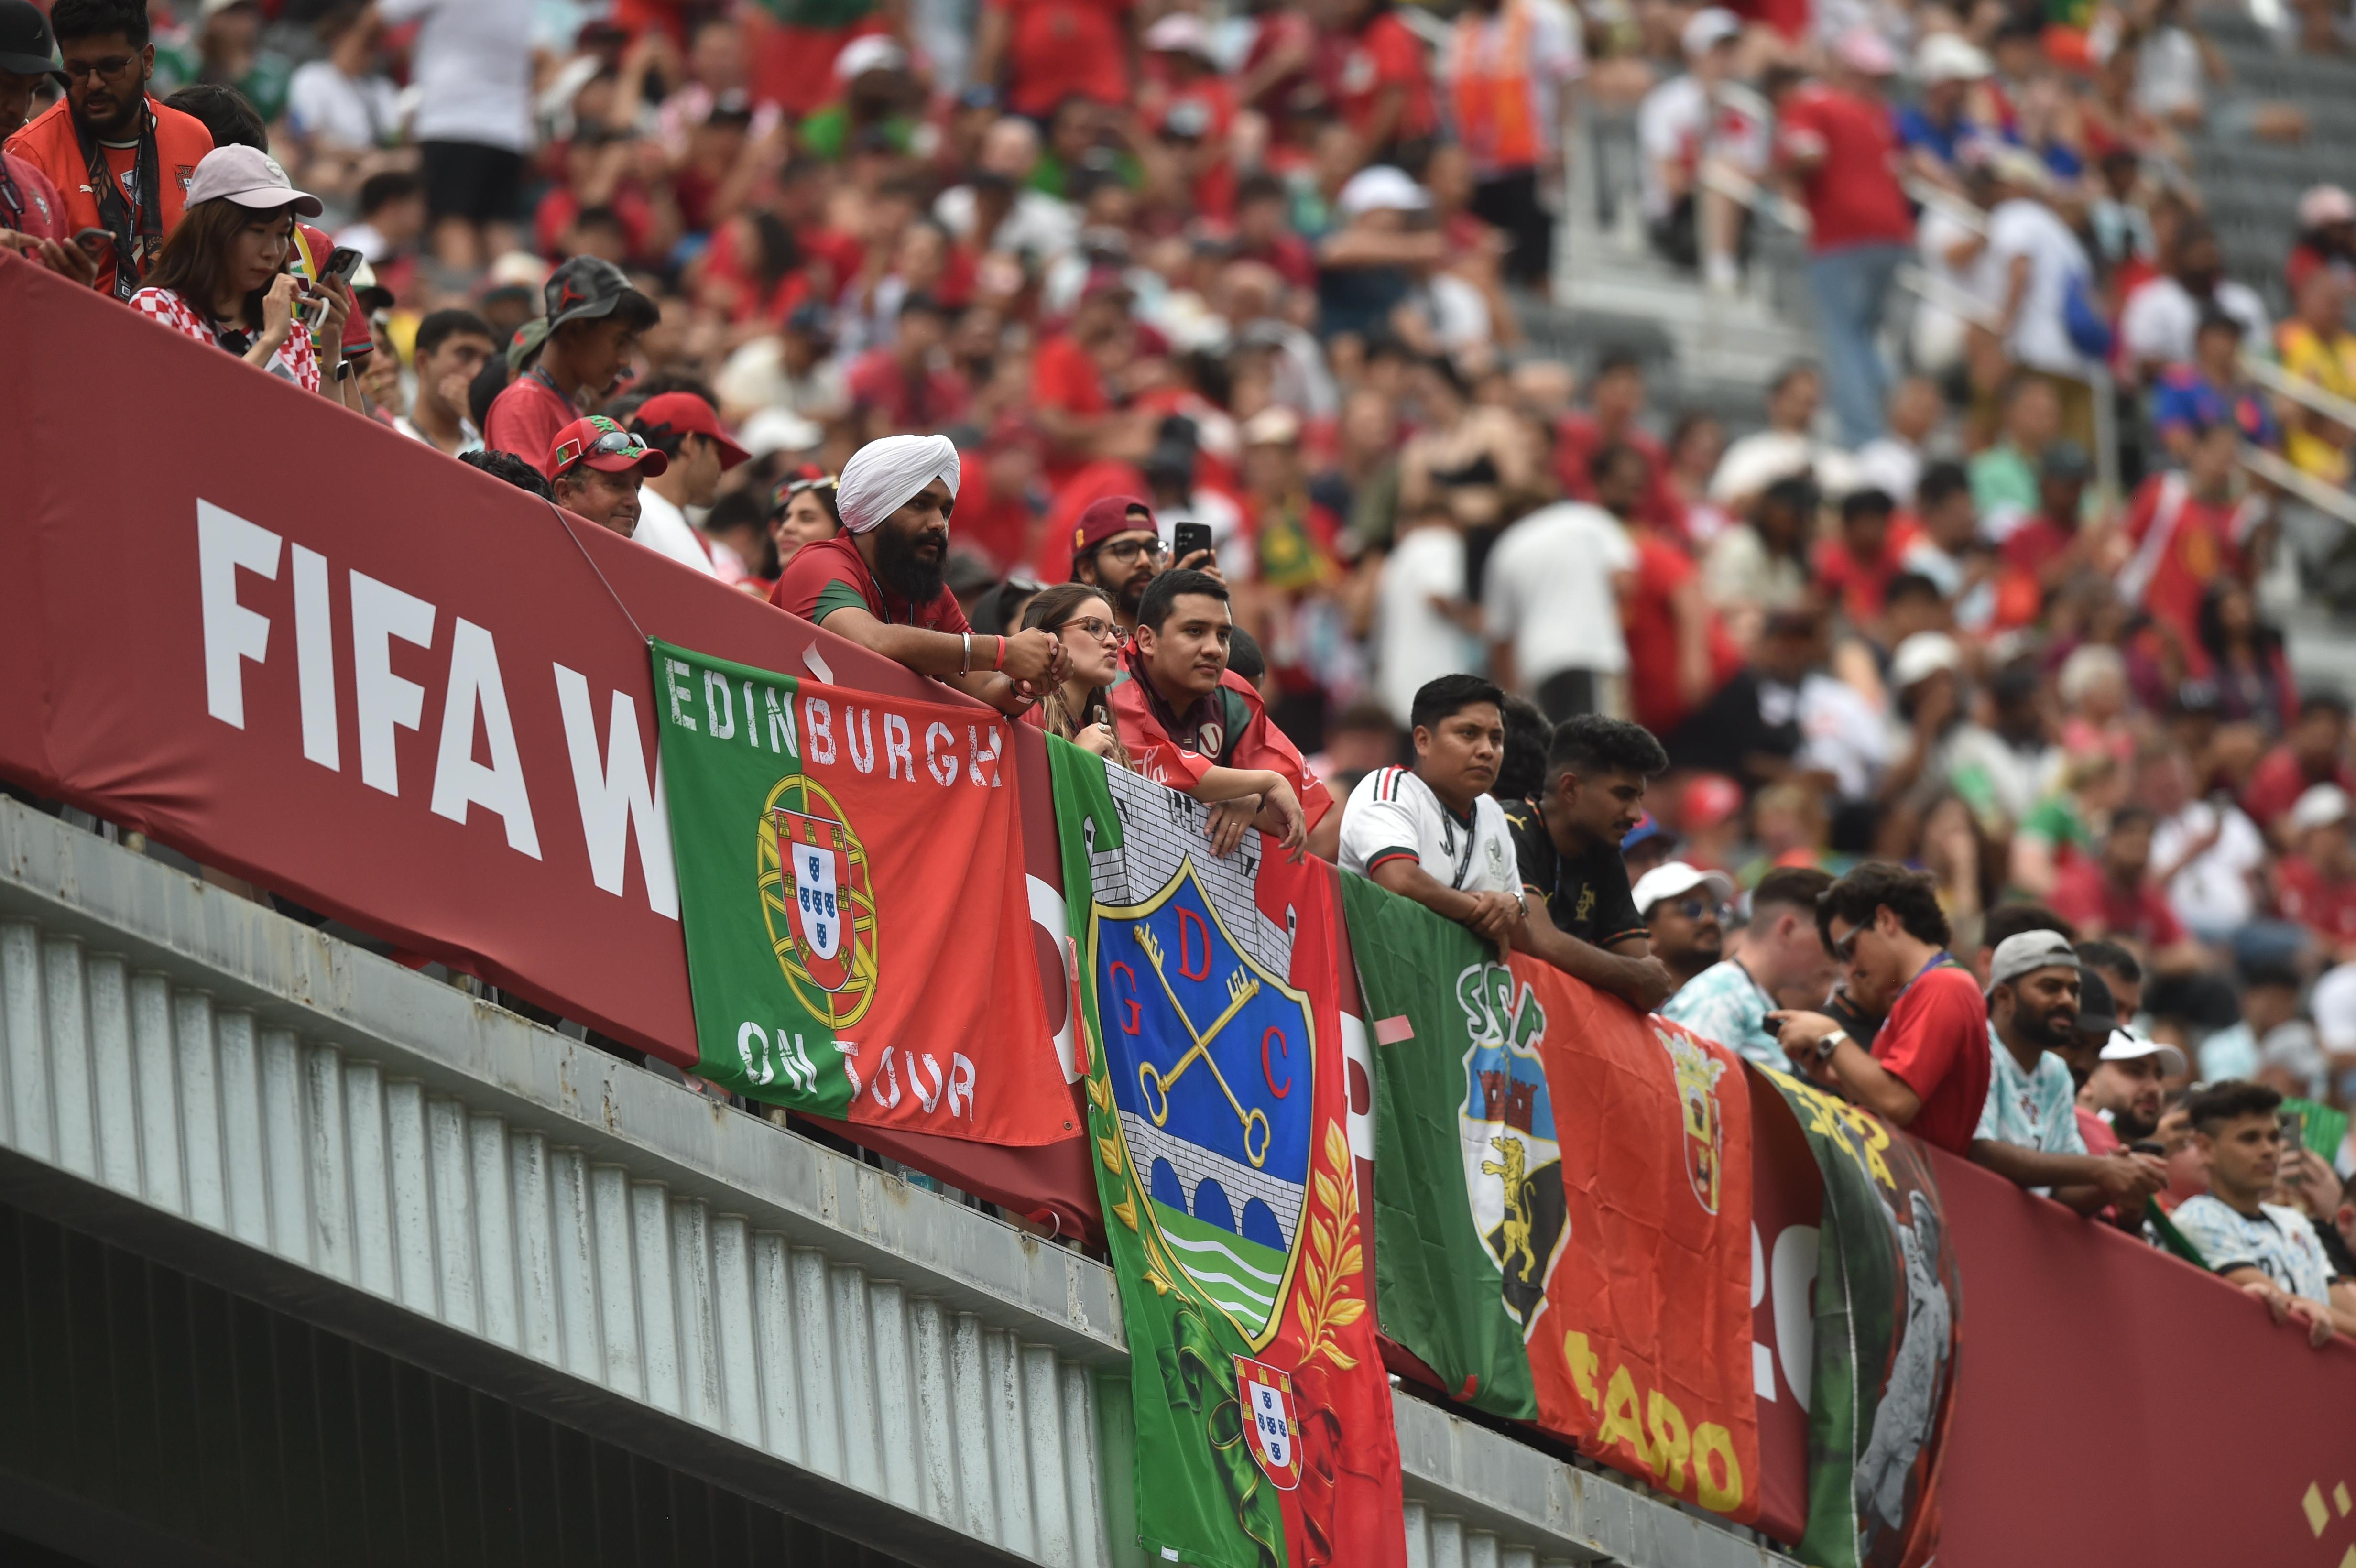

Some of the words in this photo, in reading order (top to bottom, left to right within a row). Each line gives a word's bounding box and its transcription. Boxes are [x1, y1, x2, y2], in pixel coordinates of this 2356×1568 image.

[196, 497, 543, 861] FIFA
[665, 657, 1003, 788] EDINBURGH
[738, 1021, 818, 1094] ON
[831, 1040, 977, 1123] TOUR
[1110, 960, 1142, 1035] G
[1174, 904, 1211, 981] D
[1261, 1026, 1292, 1099] C
